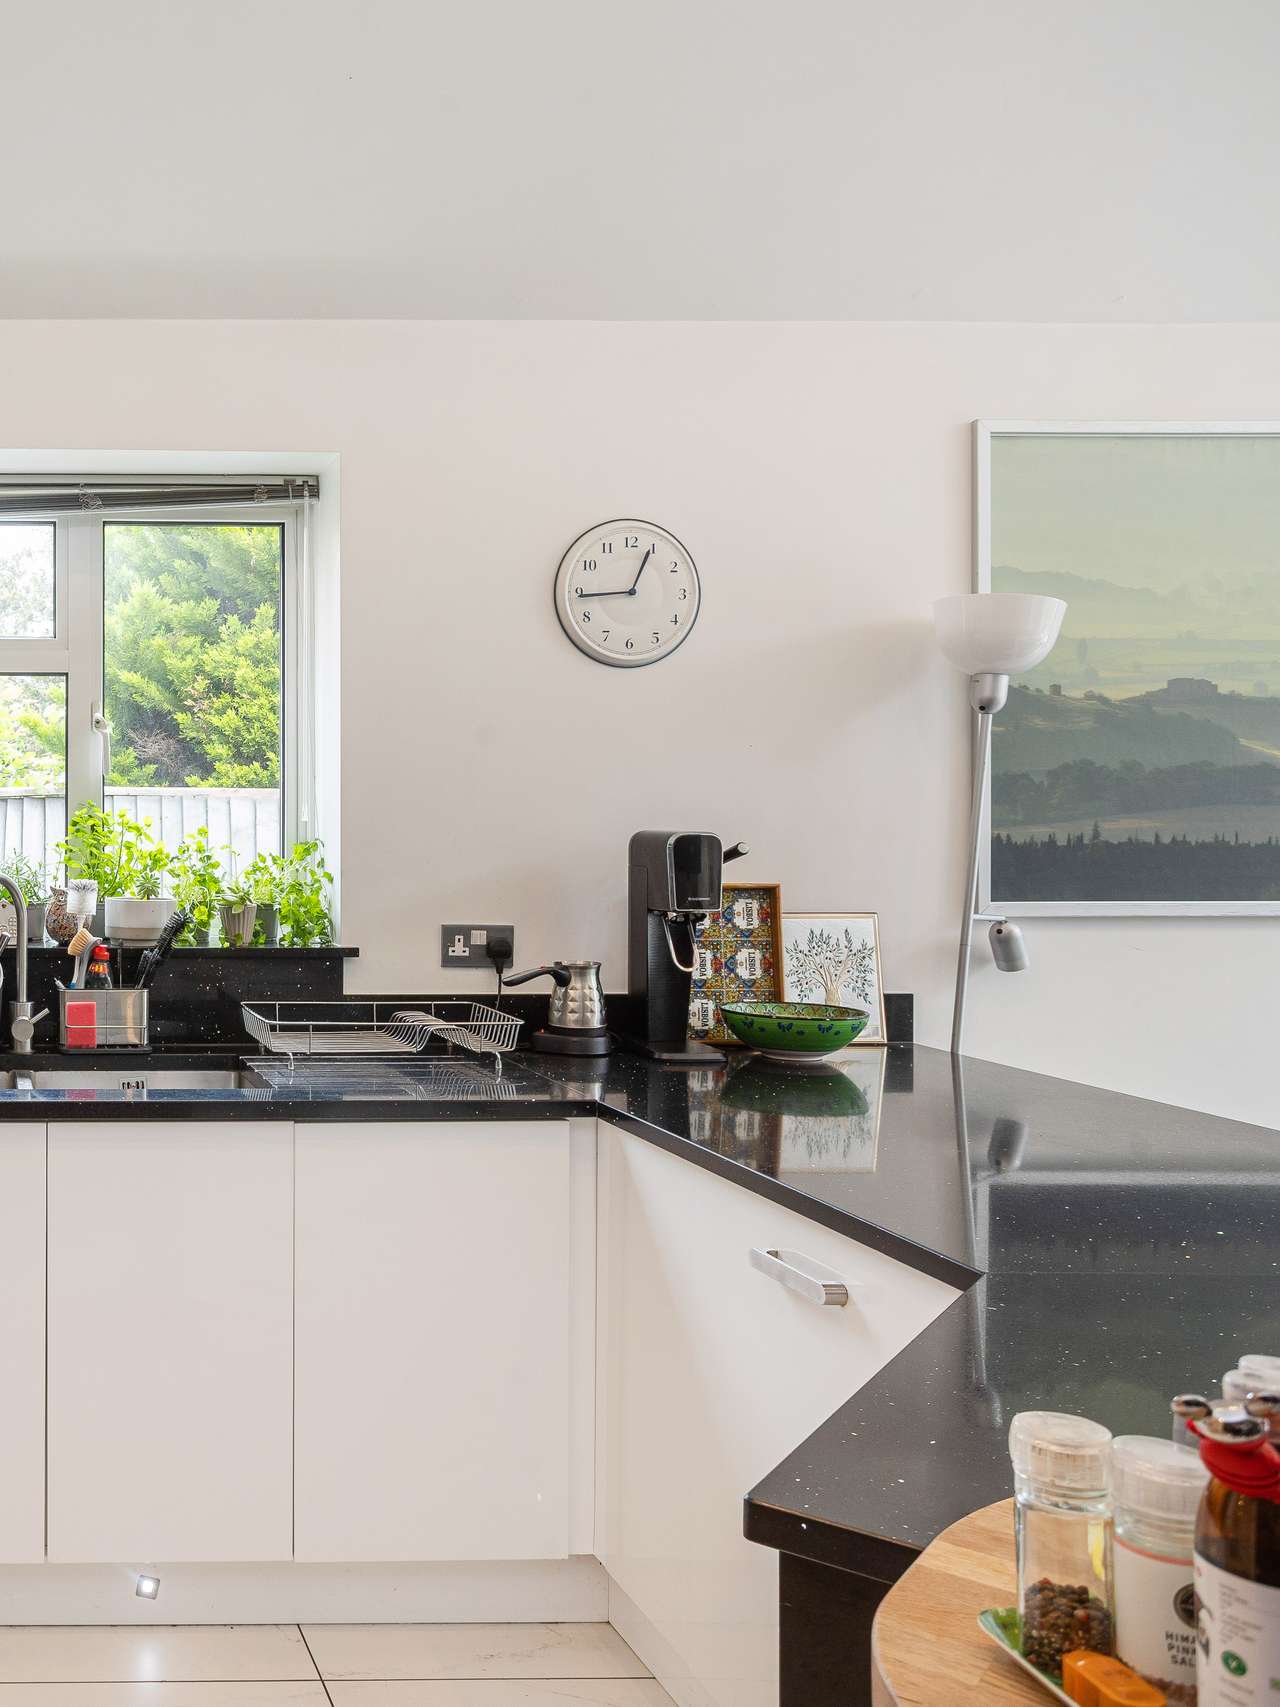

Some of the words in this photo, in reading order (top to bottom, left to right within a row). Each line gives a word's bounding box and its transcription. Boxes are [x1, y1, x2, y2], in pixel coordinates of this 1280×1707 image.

[602, 542, 613, 553] 11
[624, 536, 638, 548] 12
[583, 559, 597, 571] 10
[670, 561, 678, 573] 2
[575, 586, 584, 598] 9
[679, 588, 687, 600] 3
[582, 611, 591, 622] 8
[670, 614, 678, 625] 4
[602, 630, 610, 642] 7
[651, 632, 660, 644] 5
[625, 638, 634, 649] 6
[745, 901, 753, 927] LISBOA
[698, 951, 706, 977] LISBOA
[748, 951, 756, 977] LISBOA
[701, 1002, 709, 1028] LISBOA
